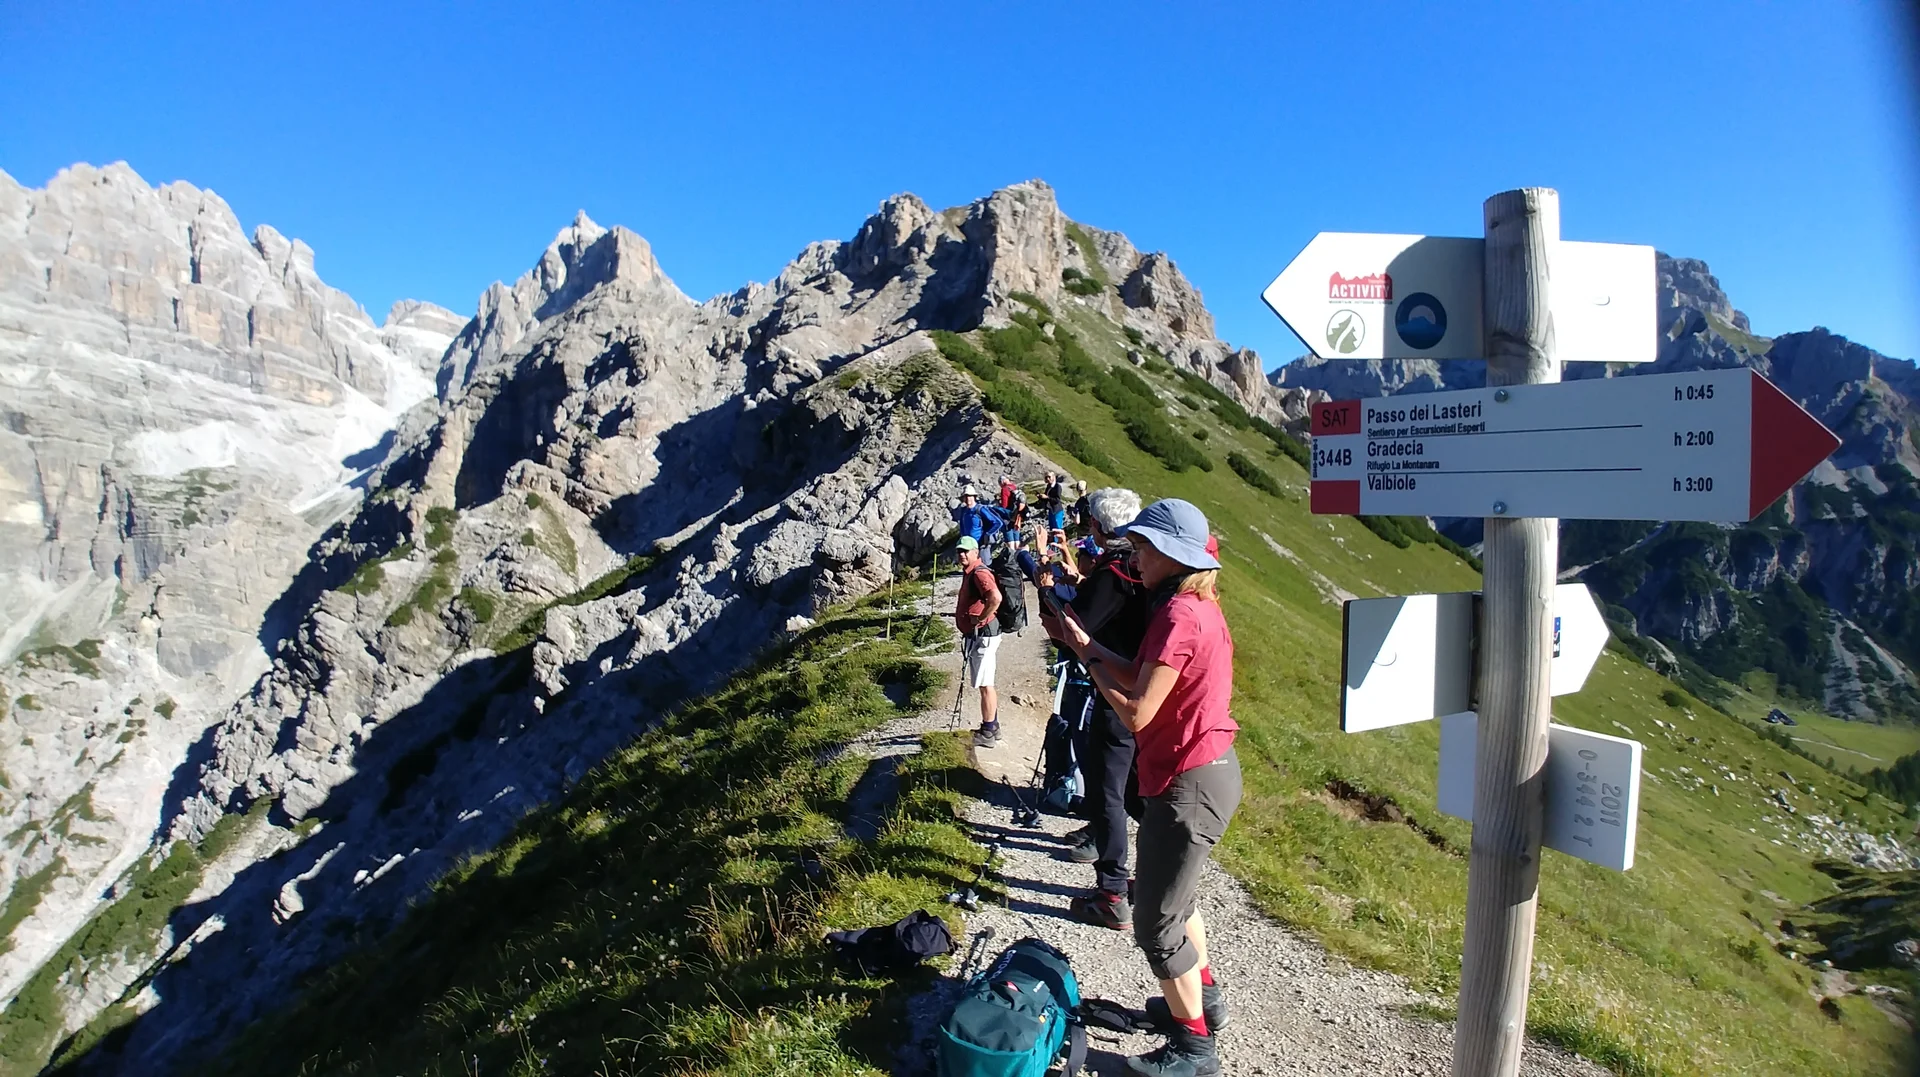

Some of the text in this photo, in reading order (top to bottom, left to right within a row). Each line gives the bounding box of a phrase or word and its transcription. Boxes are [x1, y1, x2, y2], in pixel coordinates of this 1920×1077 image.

[1330, 283, 1391, 298] ACTIVITY
[1674, 384, 1714, 401] h 0:45
[1321, 407, 1350, 428] SAT
[1367, 401, 1482, 424] Passo dei Lasteri
[1367, 421, 1486, 438] Sentiero per Escursionisti Esperti
[1673, 430, 1714, 446] h 2:00
[1367, 440, 1424, 457] Gradecia
[1318, 448, 1352, 467] 344B
[1366, 460, 1391, 472] Rifugio
[1391, 460, 1401, 470] La
[1367, 474, 1416, 491] Valbiole
[1673, 476, 1713, 492] h 3:00
[1599, 782, 1623, 827] 2011
